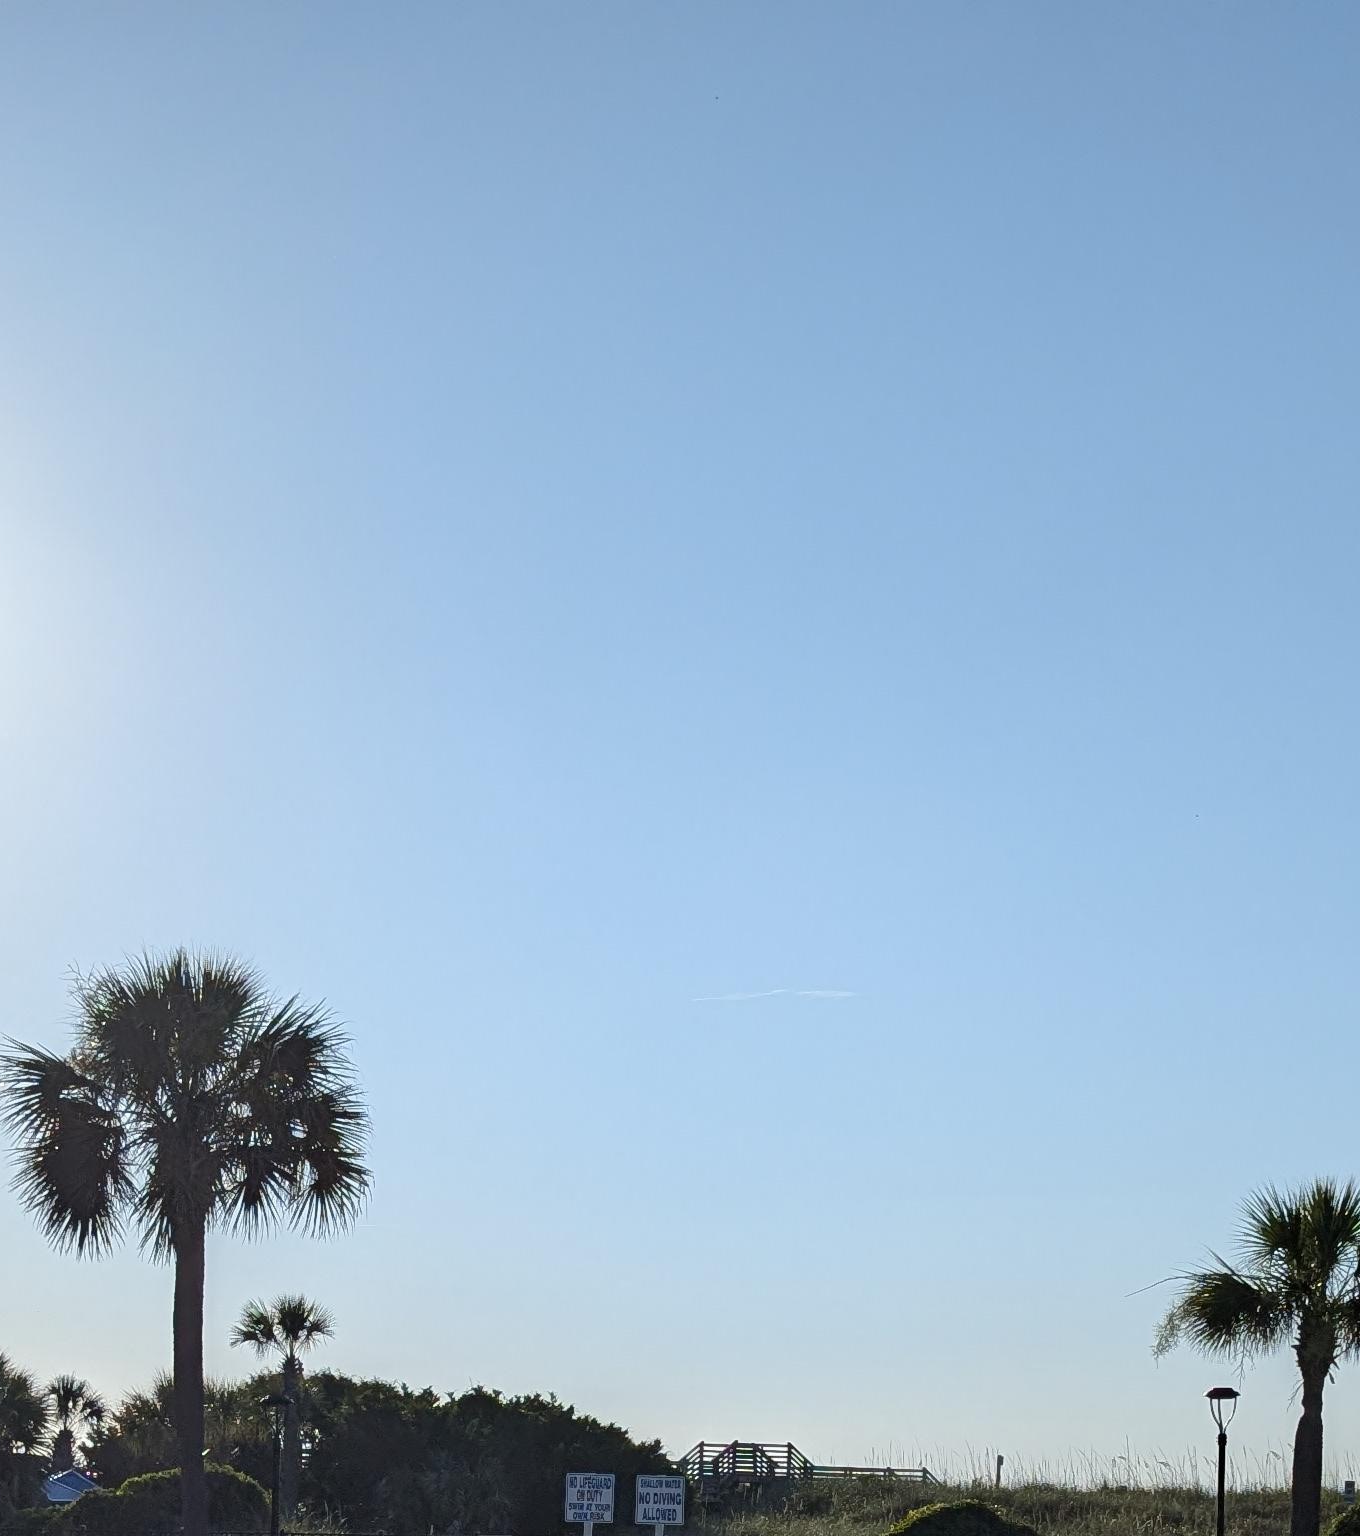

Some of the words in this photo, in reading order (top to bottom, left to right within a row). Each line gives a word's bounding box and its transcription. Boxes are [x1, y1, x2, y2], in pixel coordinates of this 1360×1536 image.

[568, 1476, 578, 1489] NO
[586, 1489, 603, 1503] DUTY
[639, 1491, 651, 1505] NO
[653, 1492, 682, 1506] DIVING
[642, 1507, 677, 1522] ALLOWED
